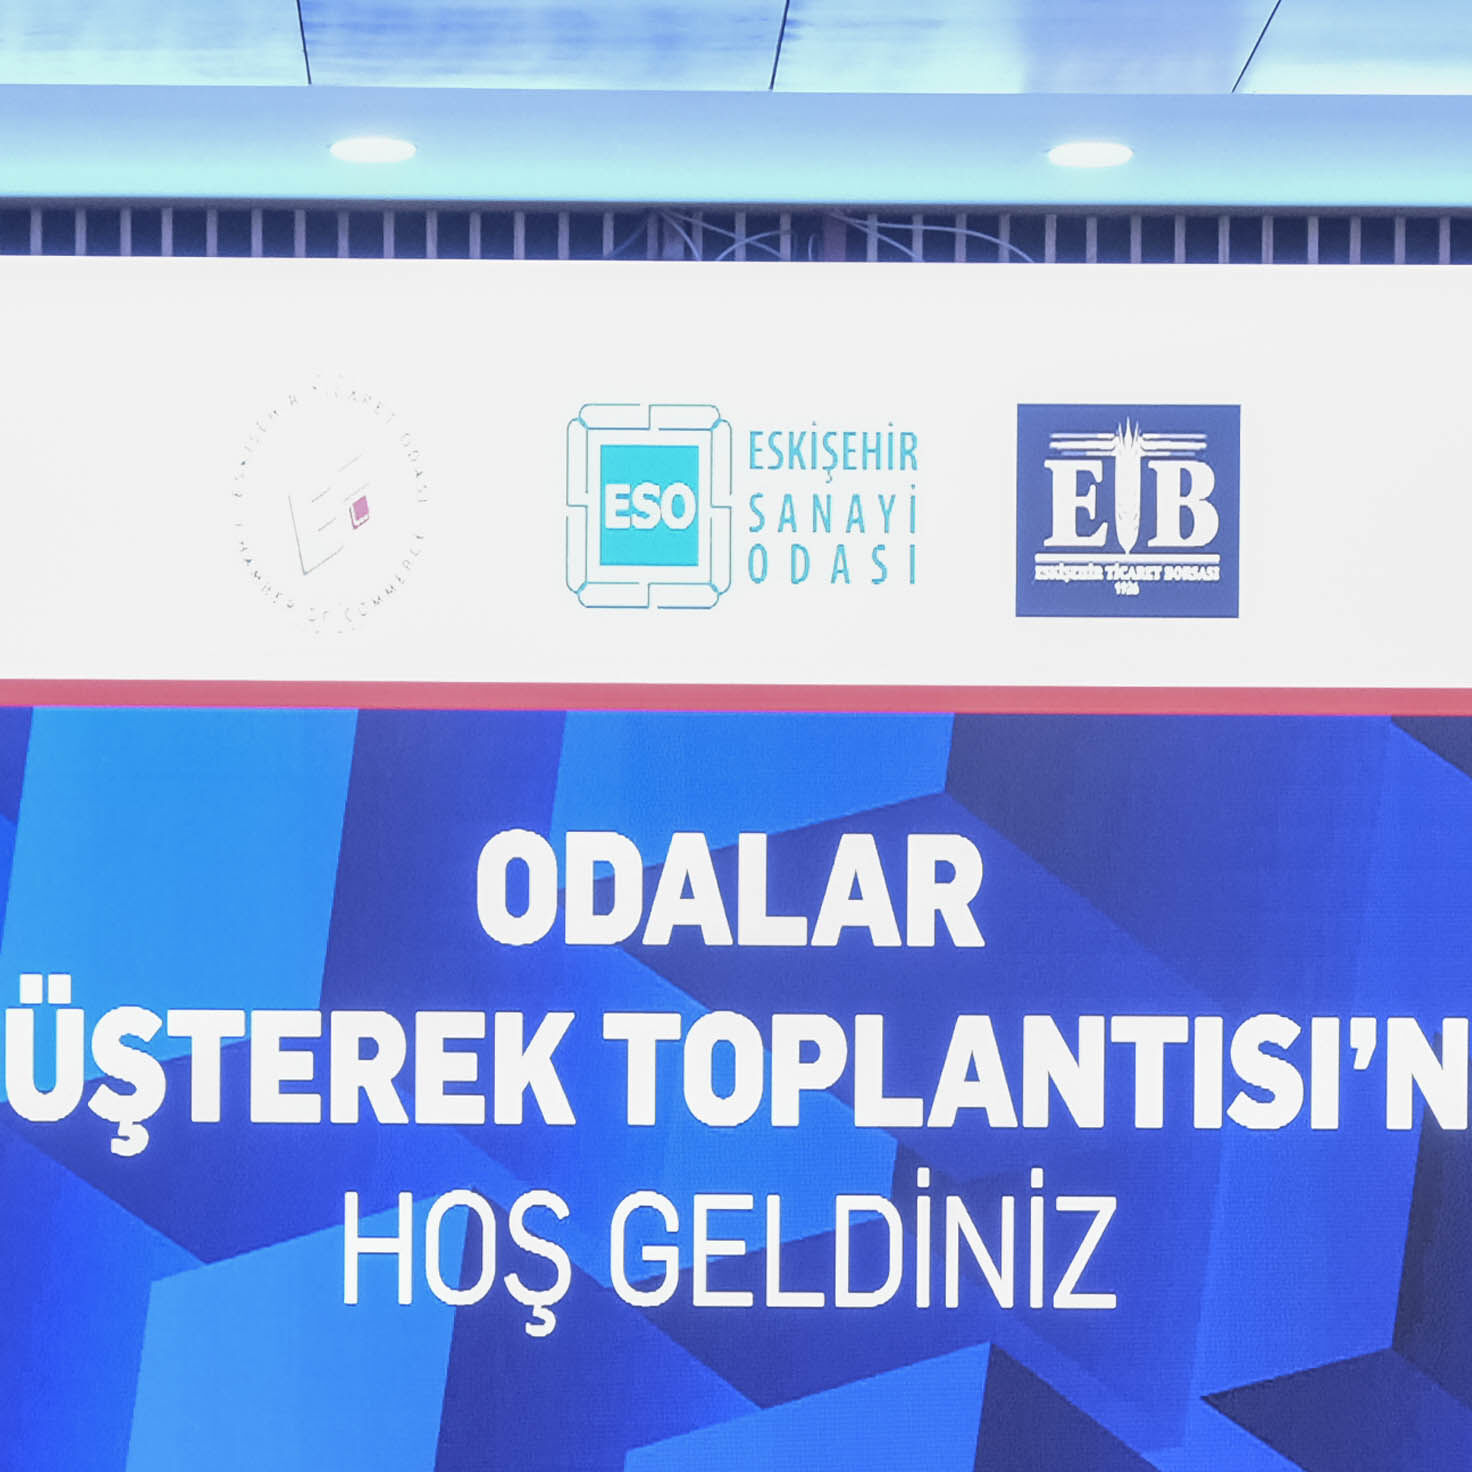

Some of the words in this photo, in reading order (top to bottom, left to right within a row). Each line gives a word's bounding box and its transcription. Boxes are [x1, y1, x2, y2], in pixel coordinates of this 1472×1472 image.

[748, 421, 919, 483] ESKİŞEHİR
[604, 482, 698, 531] ESO
[749, 484, 917, 534] SANAYİ
[748, 543, 917, 585] ODASI
[475, 828, 986, 947] ODALAR
[343, 1189, 572, 1337] HOŞ
[610, 1167, 1118, 1309] GELDİNİZ
